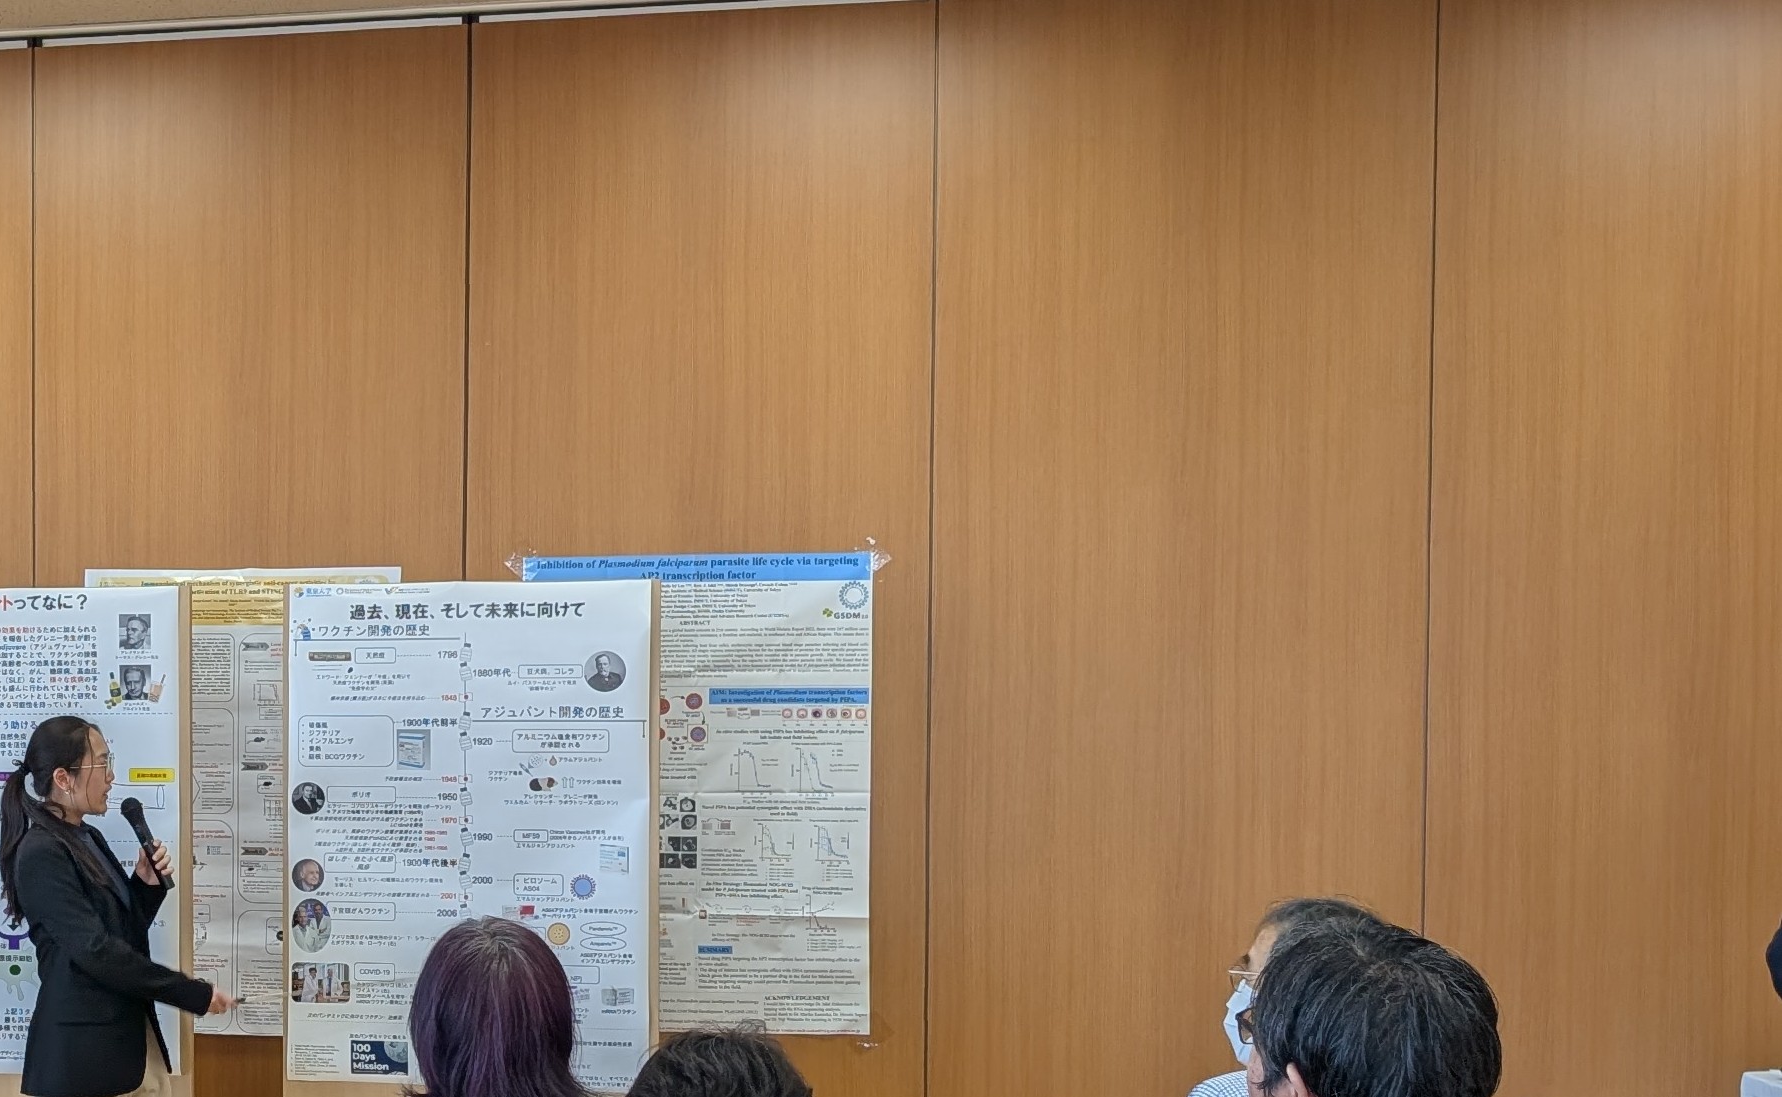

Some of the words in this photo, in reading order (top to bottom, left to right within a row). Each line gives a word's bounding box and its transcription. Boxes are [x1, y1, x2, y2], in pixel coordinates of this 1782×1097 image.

[537, 558, 583, 571] Inhibition
[585, 558, 596, 570] of
[598, 558, 654, 570] Plasmodium
[656, 557, 708, 570] falciparum
[710, 557, 750, 569] parasite
[752, 556, 767, 569] life
[770, 556, 794, 569] cycle
[797, 556, 811, 568] via
[814, 556, 859, 568] targeting
[640, 570, 660, 582] AP2
[662, 570, 725, 582] transcription
[727, 570, 757, 582] factor
[350, 601, 586, 620] 過去、現在、そして未来に向けて
[834, 612, 862, 620] GSDM
[318, 624, 430, 637] ワクチン開発の歴史
[481, 706, 624, 718] アジュバント開発の歴史
[472, 738, 492, 746] 1920
[353, 1043, 371, 1052] 100
[352, 1053, 376, 1062] Days
[353, 1062, 390, 1071] Mission
